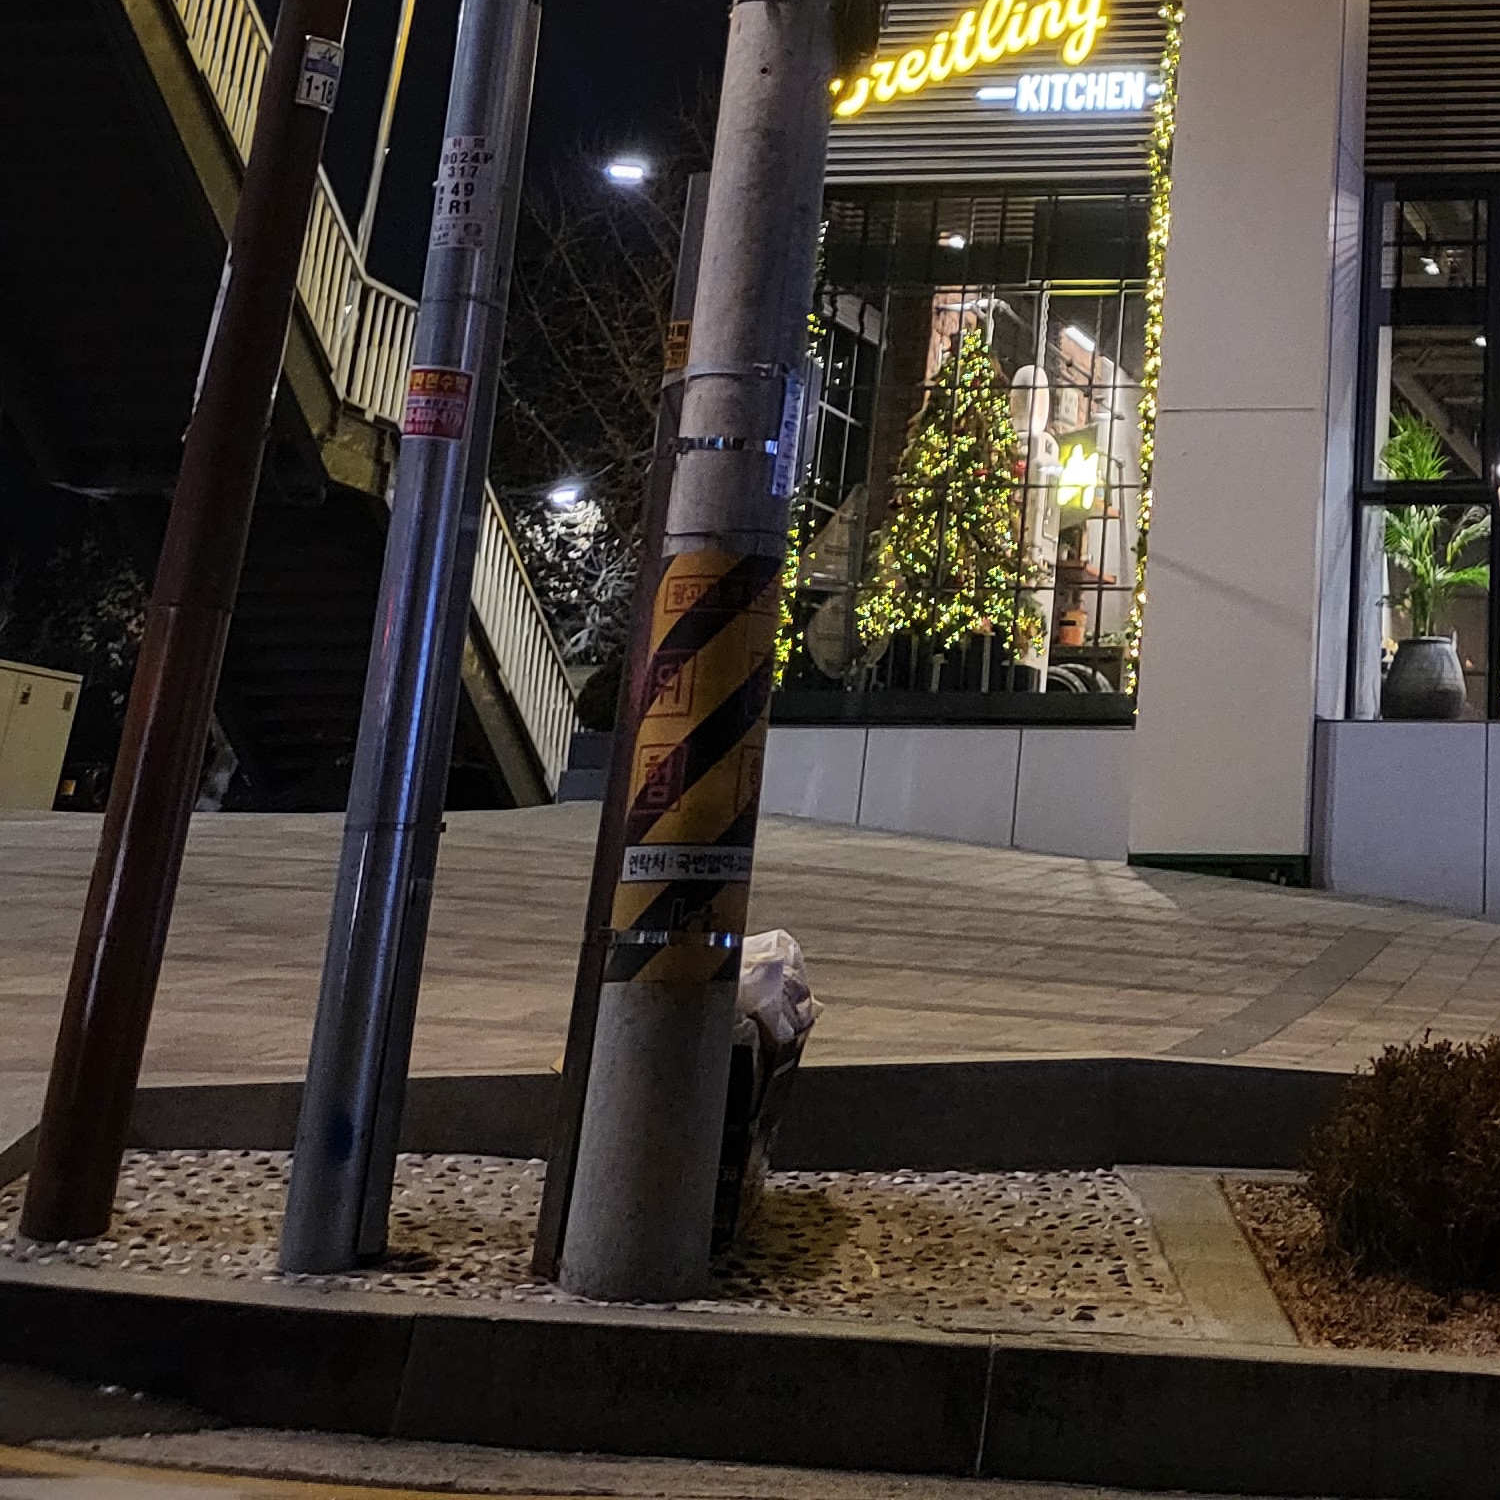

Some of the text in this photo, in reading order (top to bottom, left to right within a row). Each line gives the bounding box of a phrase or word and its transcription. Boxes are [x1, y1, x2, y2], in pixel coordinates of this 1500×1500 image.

[1016, 72, 1146, 113] KITCHEN
[447, 165, 479, 179] 317
[450, 182, 475, 198] 49
[448, 199, 471, 215] R1
